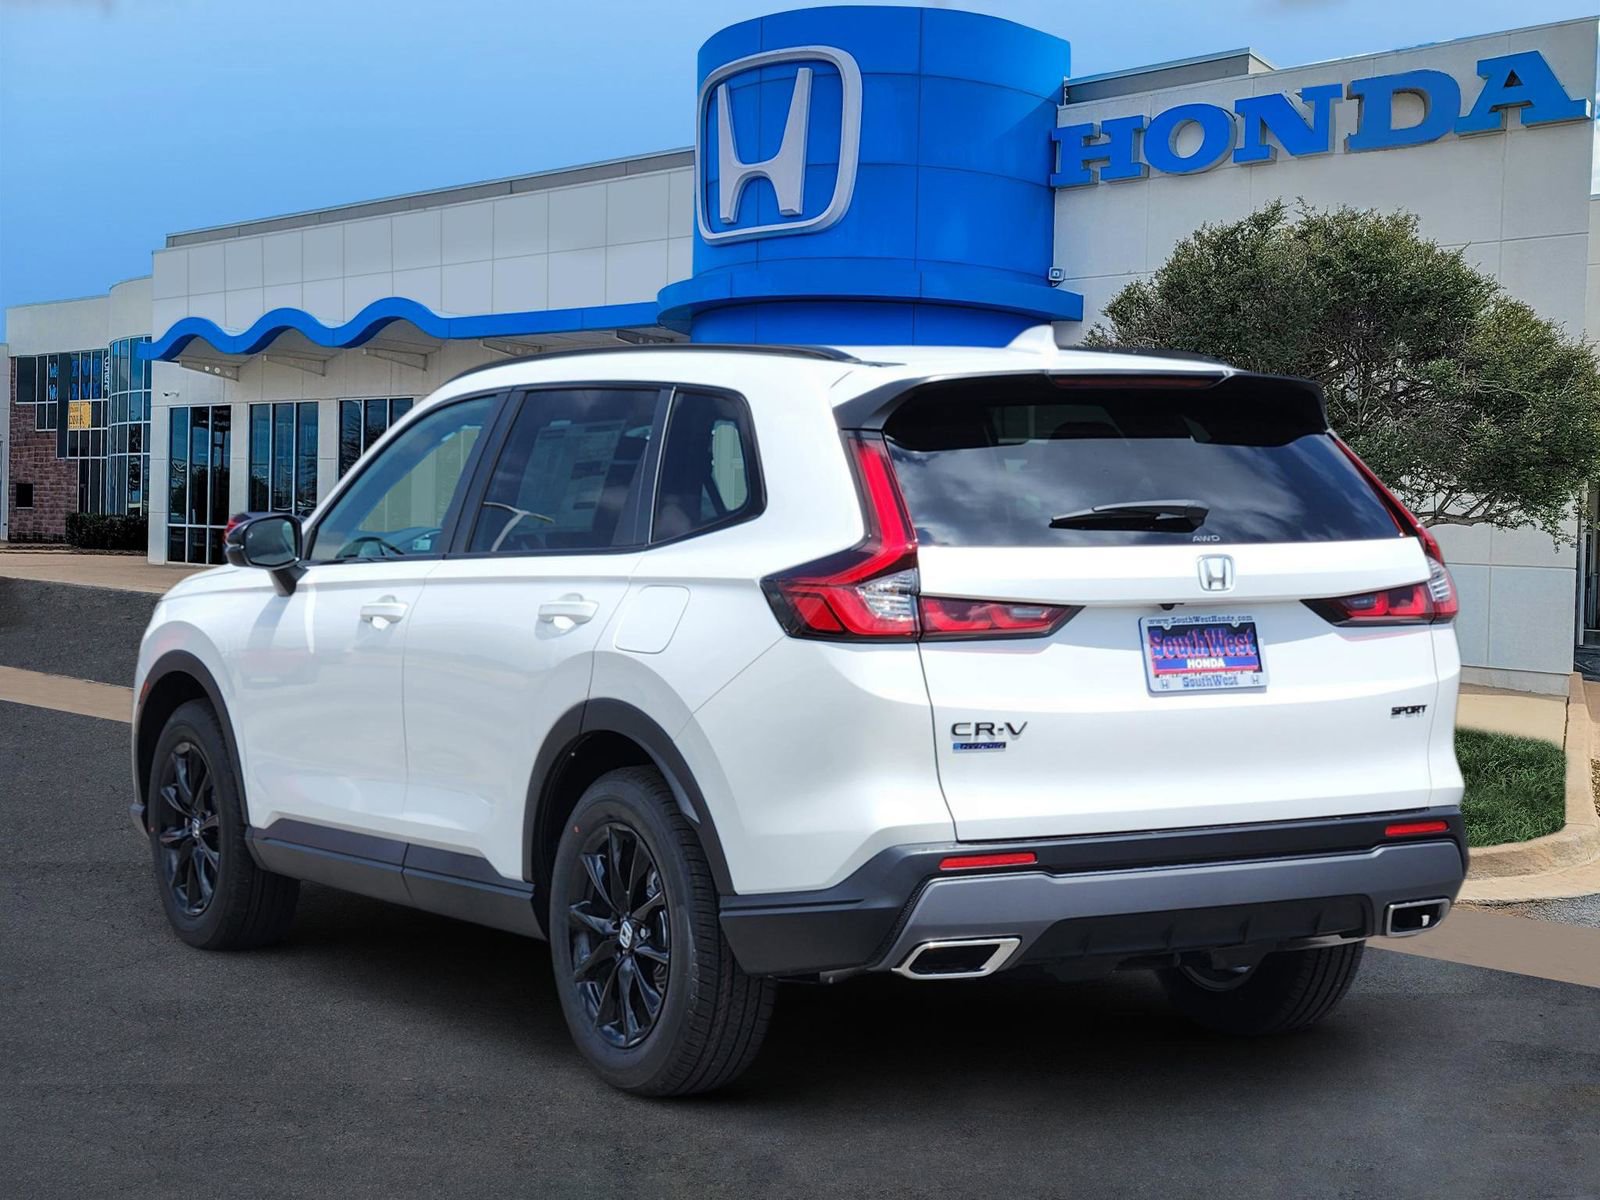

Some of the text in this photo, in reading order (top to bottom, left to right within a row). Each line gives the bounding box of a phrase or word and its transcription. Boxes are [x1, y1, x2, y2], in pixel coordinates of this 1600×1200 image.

[1050, 50, 1592, 189] HONDA
[1192, 535, 1220, 543] AWD
[1187, 657, 1227, 669] HONDA
[1391, 704, 1427, 716] SPORT
[951, 721, 1028, 737] CR-V
